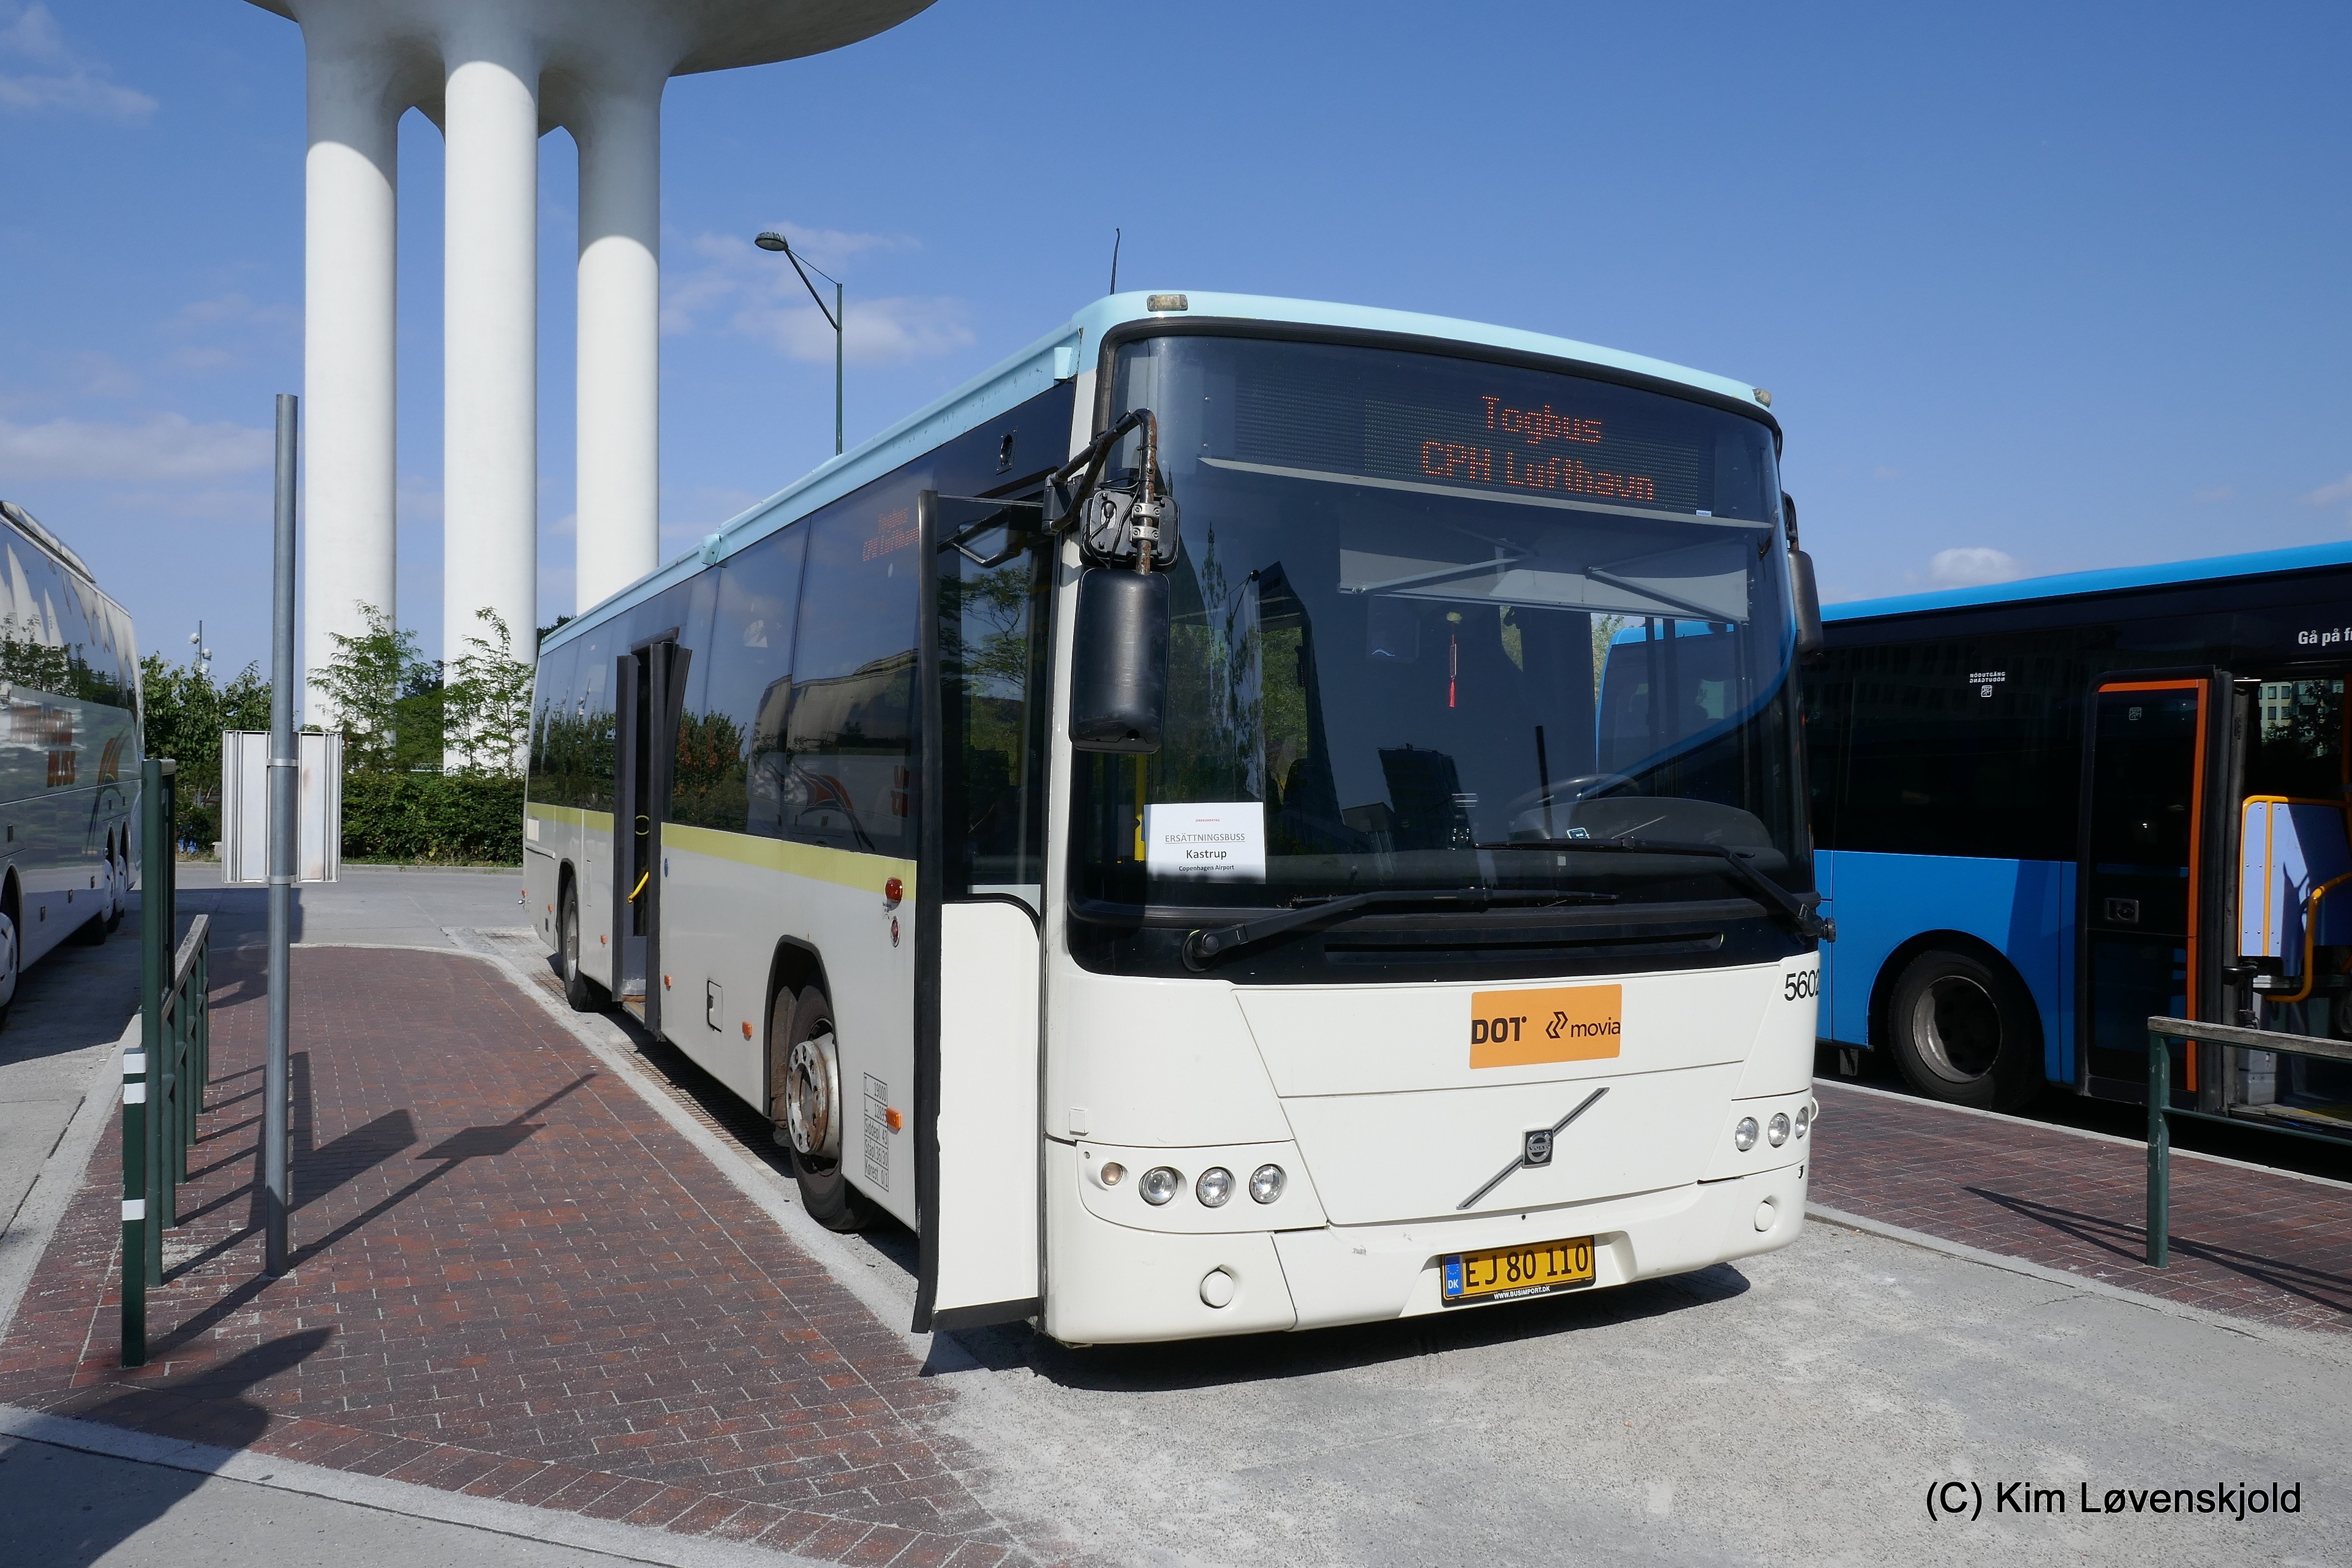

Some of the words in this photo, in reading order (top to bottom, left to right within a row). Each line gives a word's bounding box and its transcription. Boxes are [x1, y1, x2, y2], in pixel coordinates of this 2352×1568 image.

[1422, 441, 1491, 481] CPH
[1506, 451, 1654, 500] Lufthavn
[2298, 630, 2318, 644] Gå
[2321, 628, 2340, 646] på
[1165, 833, 1245, 843] ERSÄTTNINGSBUSS
[1186, 850, 1227, 860] Kastrup
[1471, 1016, 1527, 1044] DOT
[1570, 1017, 1621, 1038] movia
[1465, 1255, 1498, 1287] EJ
[1506, 1250, 1536, 1282] 80
[1546, 1243, 1588, 1276] 110
[1448, 1280, 1459, 1289] DK
[1493, 1286, 1550, 1300] WWW.BUSIMPORT.DK
